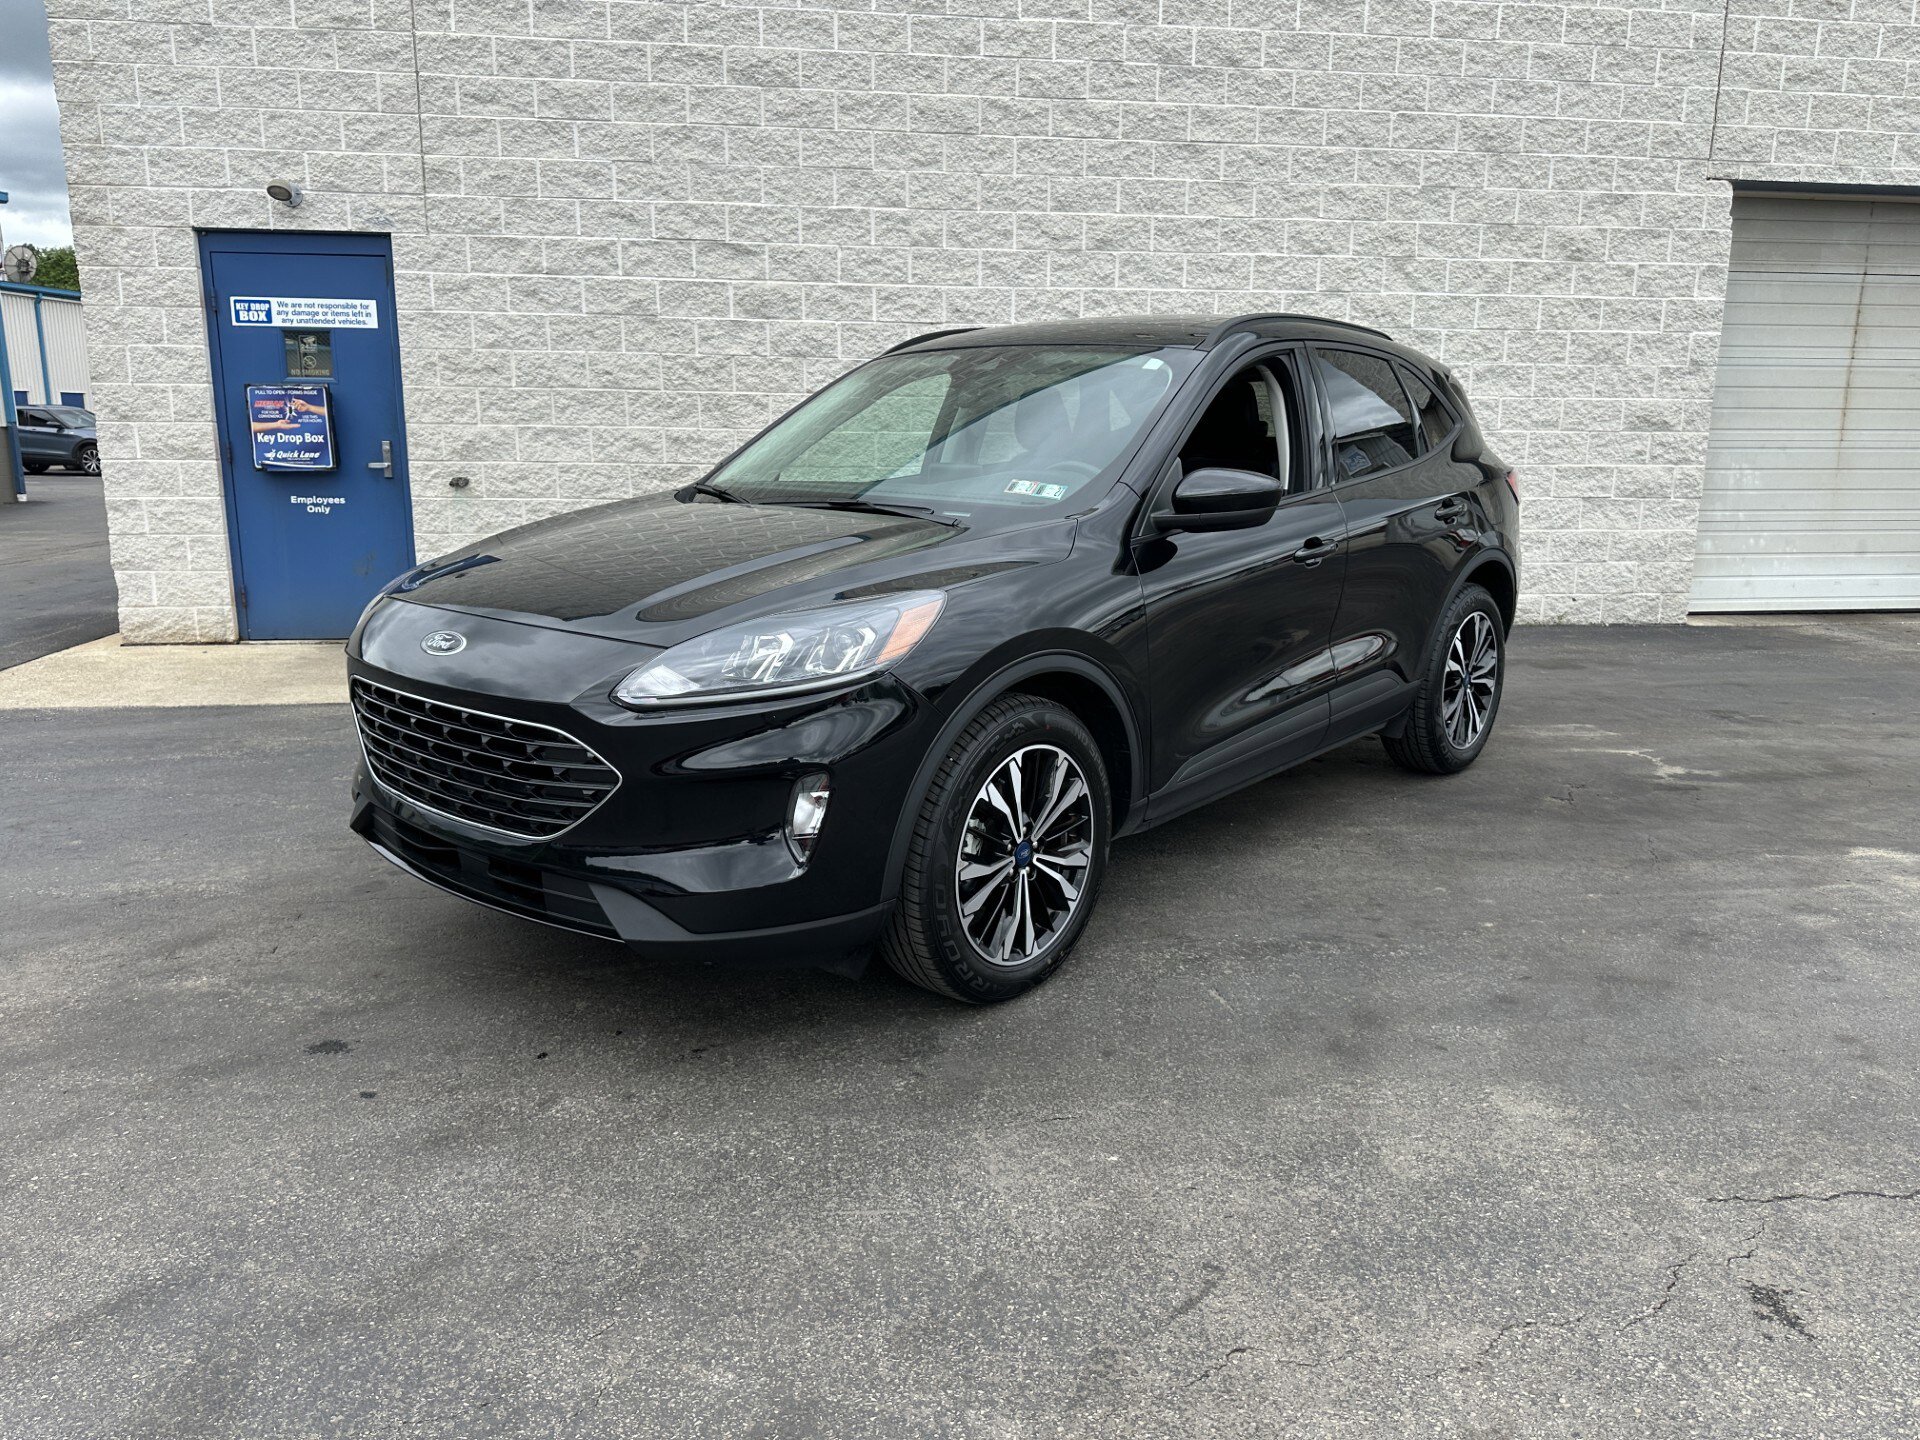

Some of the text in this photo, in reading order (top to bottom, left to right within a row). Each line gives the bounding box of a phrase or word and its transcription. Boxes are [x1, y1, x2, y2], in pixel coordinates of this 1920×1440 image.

[235, 302, 270, 311] KEY DROP
[317, 302, 357, 310] responsible
[239, 310, 268, 321] BOX
[291, 309, 320, 318] damage
[257, 433, 325, 445] Key Drop Box
[277, 450, 300, 459] Quick
[300, 450, 320, 459] Lane
[290, 495, 346, 505] Employees
[306, 505, 331, 514] Only
[427, 633, 456, 649] Ford
